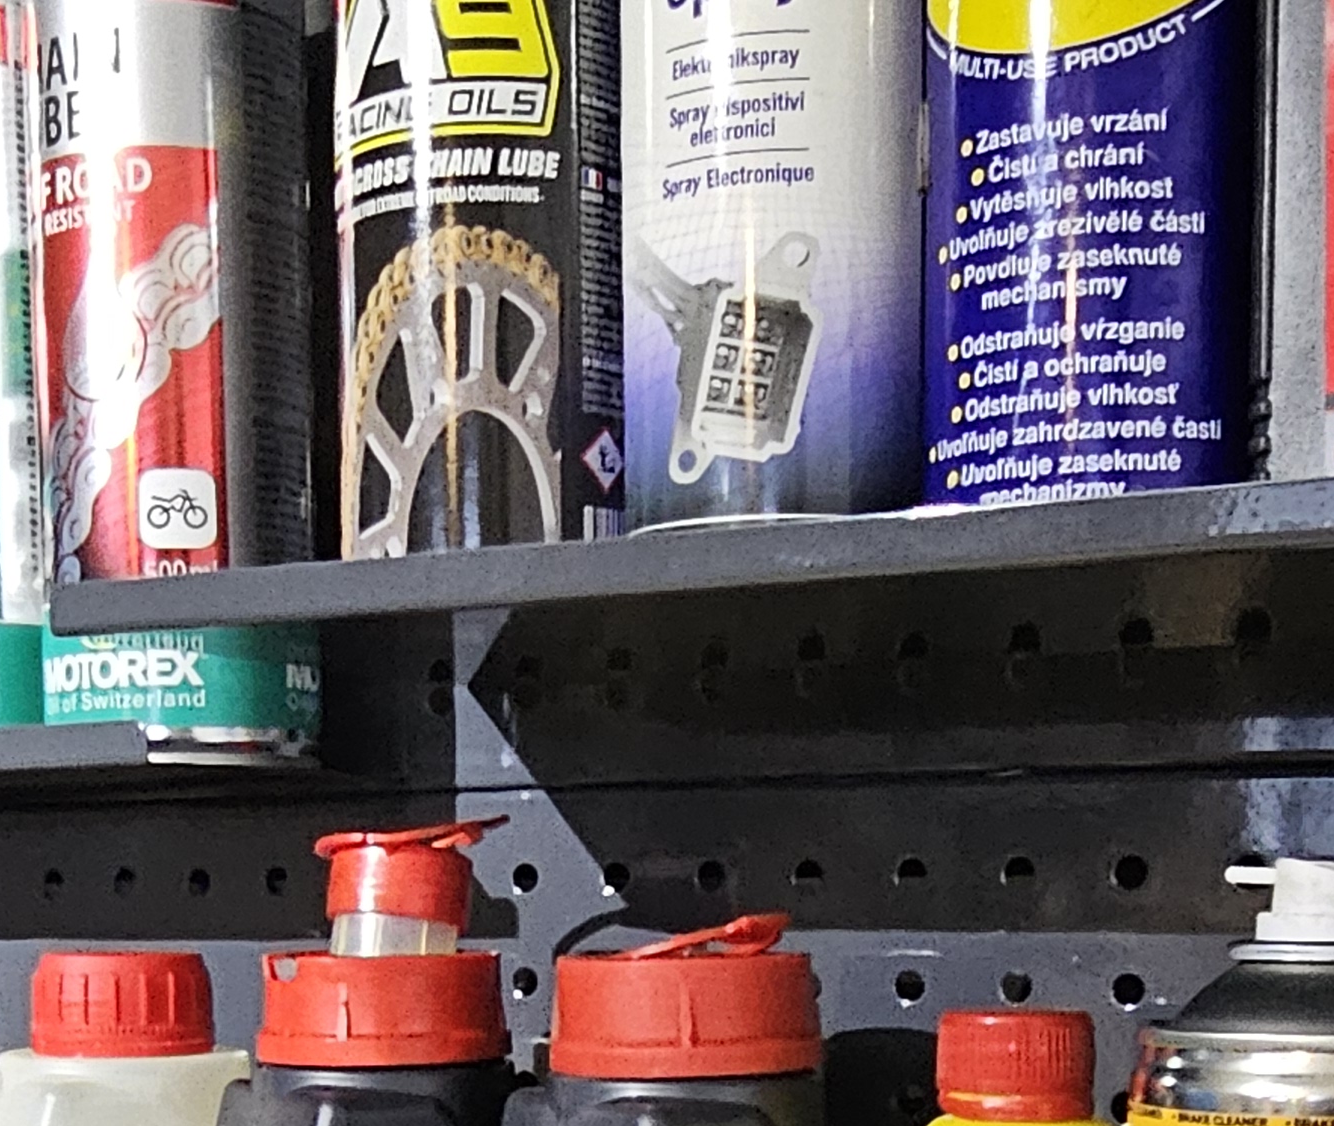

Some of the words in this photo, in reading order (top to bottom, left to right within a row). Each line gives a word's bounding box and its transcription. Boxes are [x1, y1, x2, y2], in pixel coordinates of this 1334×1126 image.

[949, 51, 1057, 80] MULTI-USE
[1064, 13, 1187, 72] PRODUCT
[672, 48, 800, 80] Elektikspray
[448, 89, 538, 115] OILS
[669, 104, 710, 130] Spray
[715, 90, 805, 118] ispositivi
[689, 117, 776, 147] eleronici
[976, 113, 1084, 154] Zastavuje
[1090, 107, 1168, 134] vrzání
[422, 147, 494, 178] HAIN
[498, 147, 560, 178] LUBE
[1064, 141, 1145, 169] chrání
[662, 176, 701, 200] Spray
[706, 163, 816, 189] Electronique
[1085, 177, 1173, 200] vlhkost
[44, 200, 137, 236] RESISTNT
[1150, 208, 1205, 234] části
[1057, 244, 1182, 271] zaseknuté
[981, 276, 1127, 311] mechansmy
[960, 320, 1075, 359] Odstraňuje
[974, 359, 1017, 387] Čistí
[1023, 360, 1038, 380] a
[1044, 350, 1166, 377] ochraňuje
[965, 386, 1081, 423] Odstraňuje
[1012, 416, 1165, 446] zahrdzavené
[1058, 449, 1182, 475] zaseknuté
[44, 651, 204, 693] MOTOREX
[81, 689, 206, 711] Switzerland
